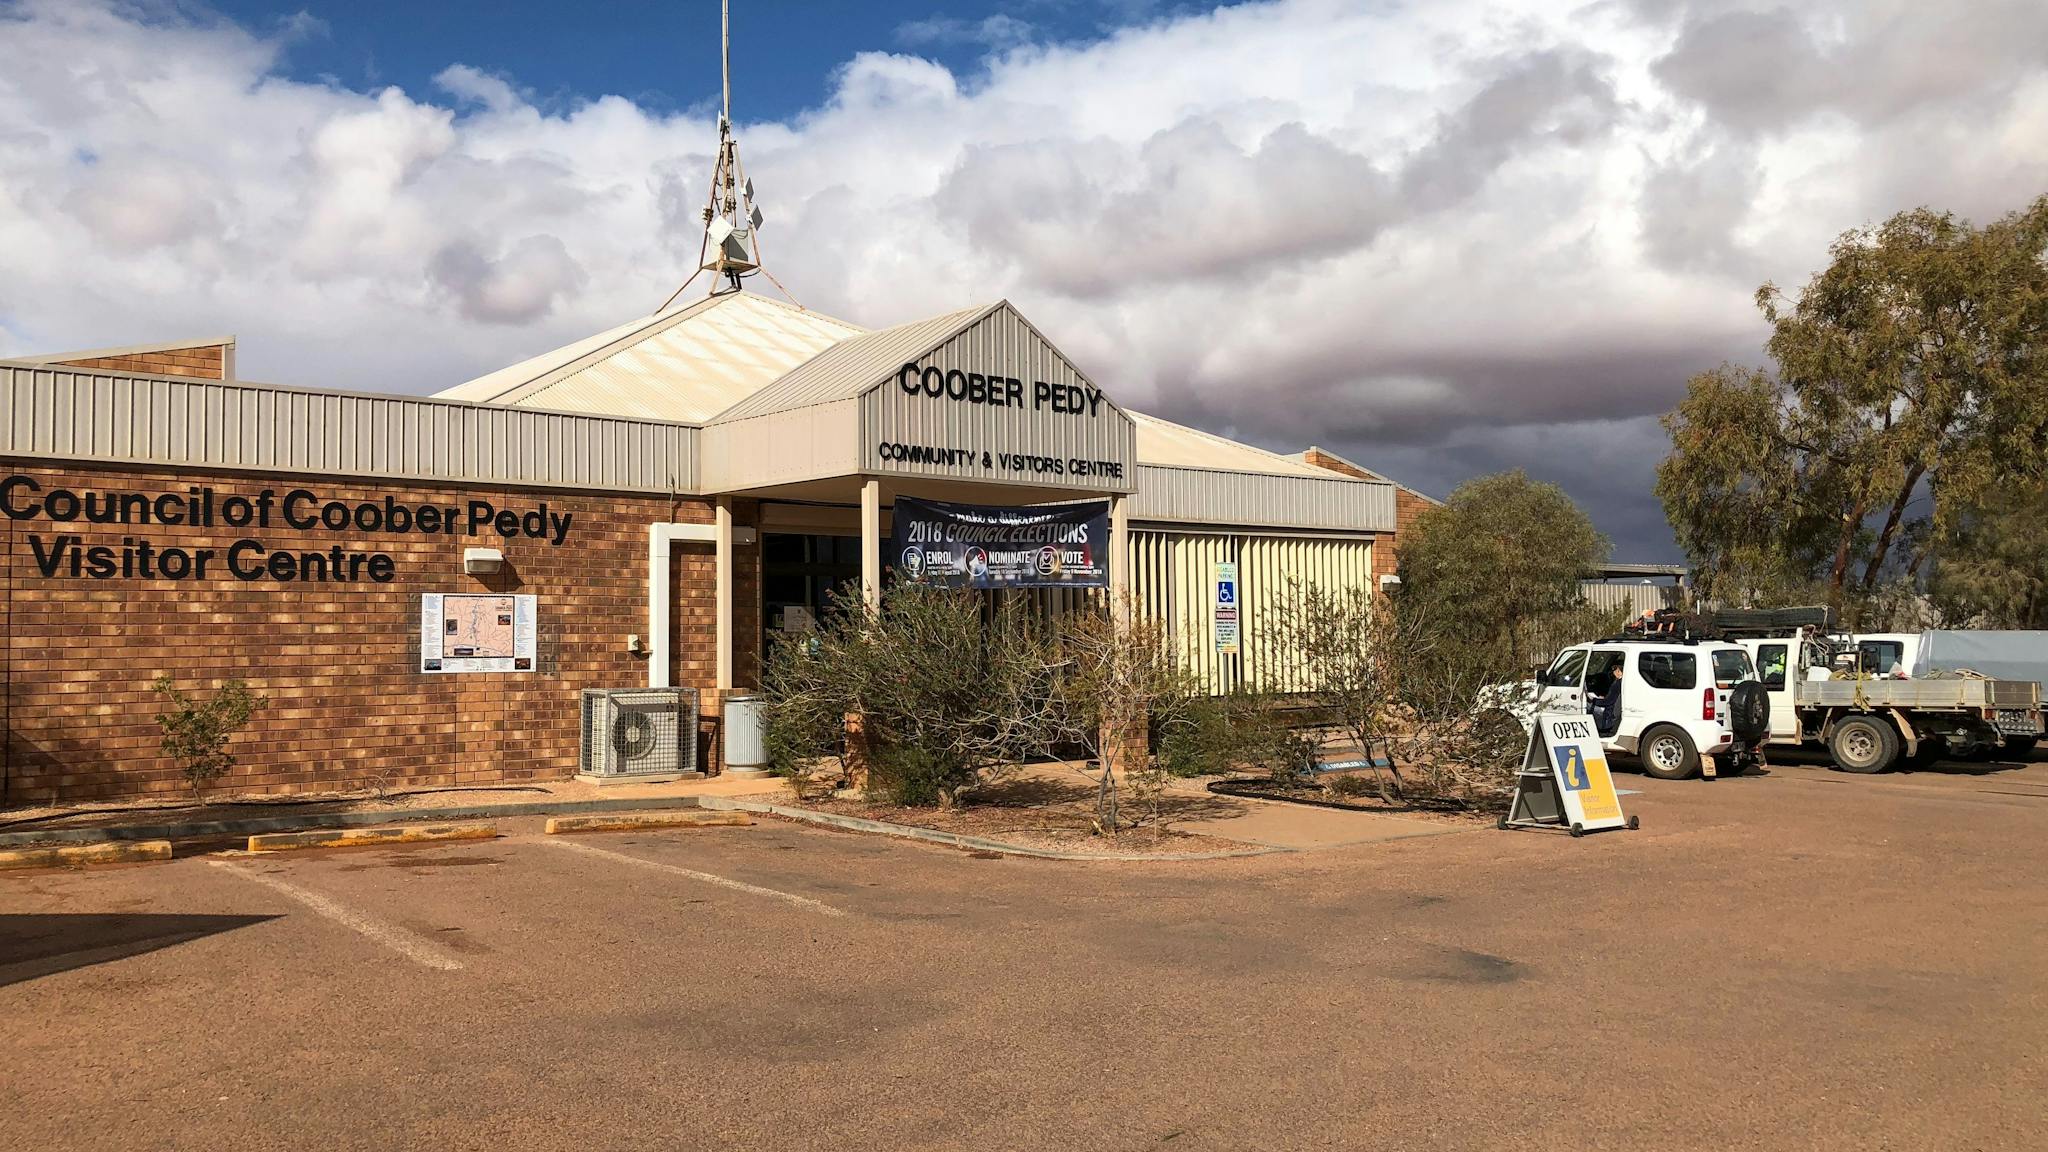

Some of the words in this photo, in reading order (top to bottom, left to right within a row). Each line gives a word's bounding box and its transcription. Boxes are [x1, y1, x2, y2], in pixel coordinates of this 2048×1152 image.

[900, 362, 1024, 409] COOBER
[1034, 380, 1102, 418] PEDY
[879, 441, 977, 468] COMMUNITY
[982, 451, 993, 470] &
[999, 452, 1064, 475] VISITORS
[1068, 458, 1123, 479] CENTRE
[0, 475, 213, 527] Council
[222, 490, 274, 528] of
[283, 489, 460, 535] Coober
[468, 500, 573, 546] Pedy
[908, 521, 942, 543] 2018
[946, 523, 1007, 543] COUNCIL
[1010, 523, 1089, 544] ELECTIONS
[28, 534, 215, 581] Visitor
[227, 539, 395, 582] Centre
[926, 551, 954, 565] ENROL
[988, 551, 1031, 565] NOMINATE
[1061, 551, 1084, 565] VOTE
[1553, 721, 1591, 740] OPEN
